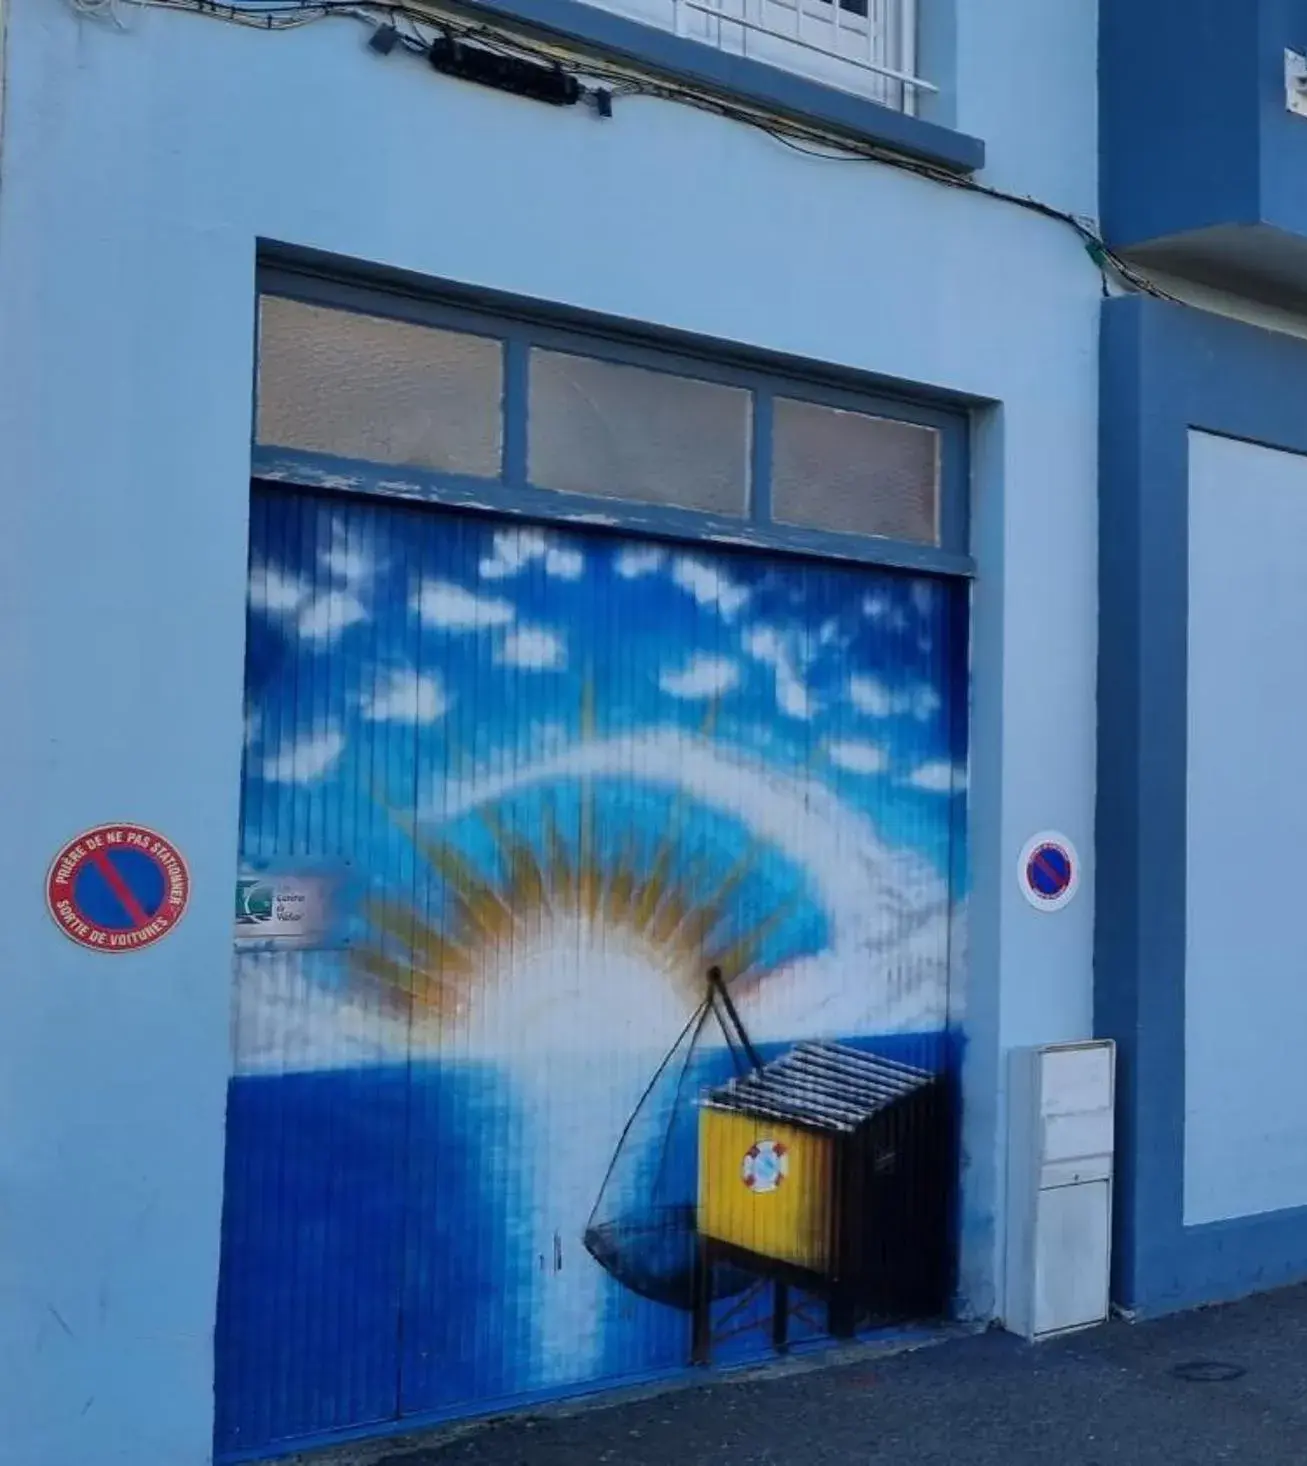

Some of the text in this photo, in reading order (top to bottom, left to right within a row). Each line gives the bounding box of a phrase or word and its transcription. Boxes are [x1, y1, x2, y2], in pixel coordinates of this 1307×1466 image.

[86, 835, 105, 850] DE
[106, 831, 124, 844] NE
[127, 831, 151, 849] PAS
[150, 842, 184, 905] STATIONNER
[56, 899, 168, 946] SORTIE DE VOITURES
